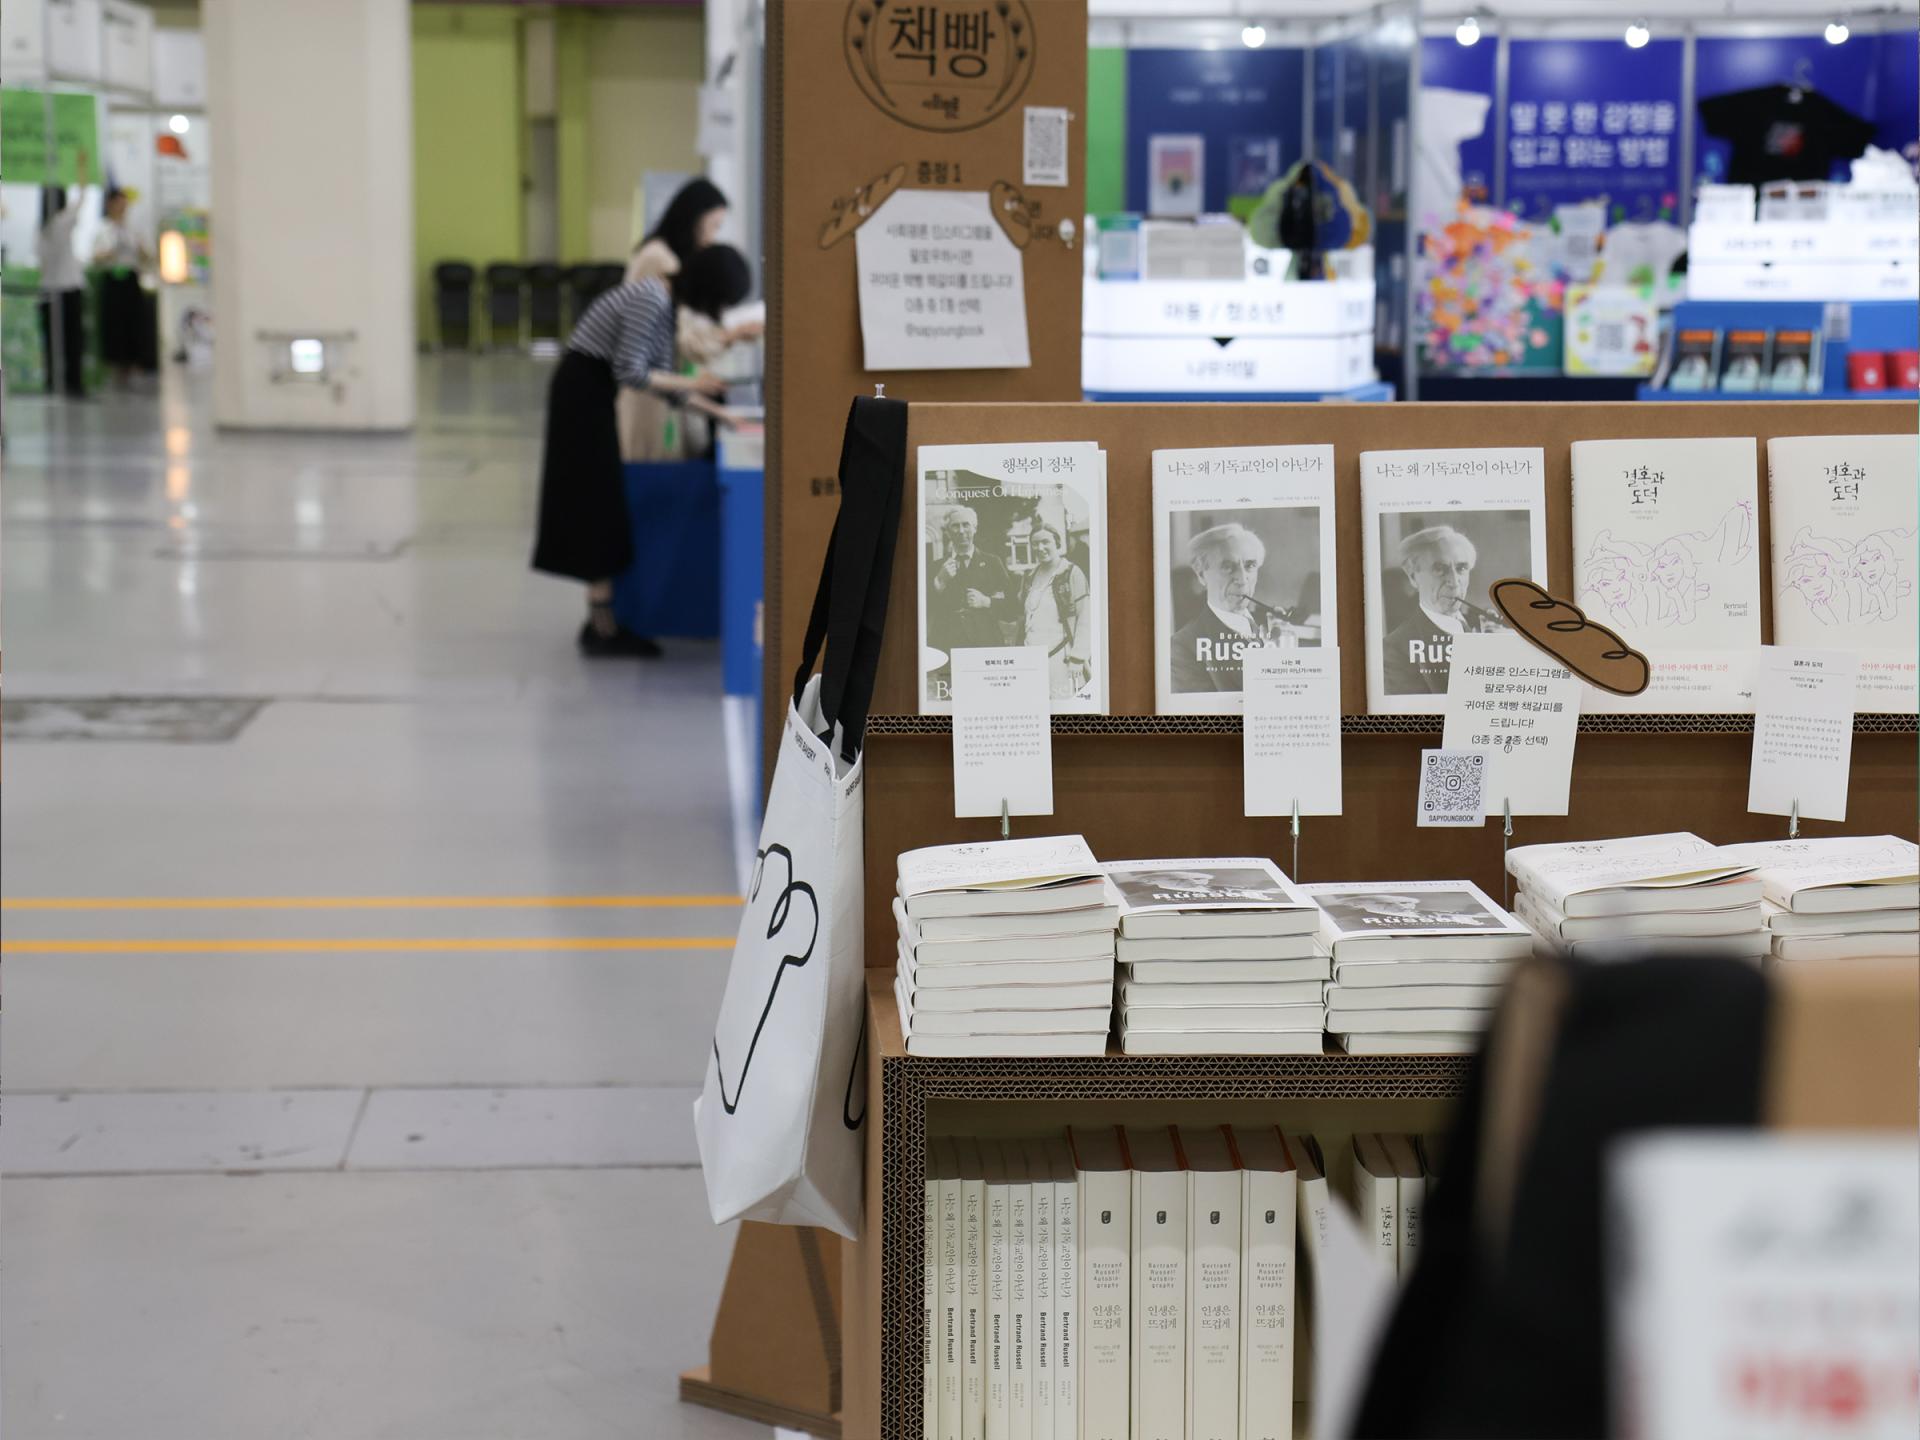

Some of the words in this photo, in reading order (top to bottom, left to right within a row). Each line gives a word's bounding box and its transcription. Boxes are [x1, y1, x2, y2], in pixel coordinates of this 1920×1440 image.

[889, 6, 996, 78] 책빵
[1002, 457, 1042, 473] 행복의
[1048, 457, 1076, 472] 정복
[1168, 461, 1194, 476] 나는
[1198, 460, 1210, 475] 왜
[1213, 458, 1279, 475] 기독교인이
[1281, 456, 1323, 473] 아닌가
[1377, 463, 1403, 478] 나는
[1407, 462, 1419, 477] 왜
[1422, 461, 1488, 477] 기독교인이
[1491, 460, 1532, 475] 아닌가
[1623, 465, 1664, 487] 결혼과
[1824, 462, 1866, 483] 결혼과
[1632, 487, 1657, 504] 도덕
[1832, 483, 1859, 501] 도덕
[1464, 665, 1506, 679] 사회평론
[1484, 683, 1548, 695] 팔로우하시면
[1464, 700, 1495, 711] 귀여운
[1498, 700, 1519, 711] 책빵
[1521, 701, 1564, 713] 책갈피를
[1489, 718, 1534, 728] 드립니다!
[1471, 735, 1491, 745] (3종
[1493, 735, 1503, 745] 중
[1525, 735, 1549, 746] 선택)
[1381, 1205, 1393, 1229] 결혼과
[1382, 1232, 1392, 1246] 도덕
[1092, 1305, 1122, 1316] 인생은
[1148, 1305, 1178, 1316] 인생은
[1201, 1305, 1231, 1316] 인생은
[1256, 1304, 1285, 1316] 인생은
[1093, 1317, 1121, 1328] 뜨겁게
[1148, 1318, 1176, 1329] 뜨겁게
[1202, 1318, 1230, 1329] 뜨겁게
[1256, 1317, 1284, 1328] 뜨겁게
